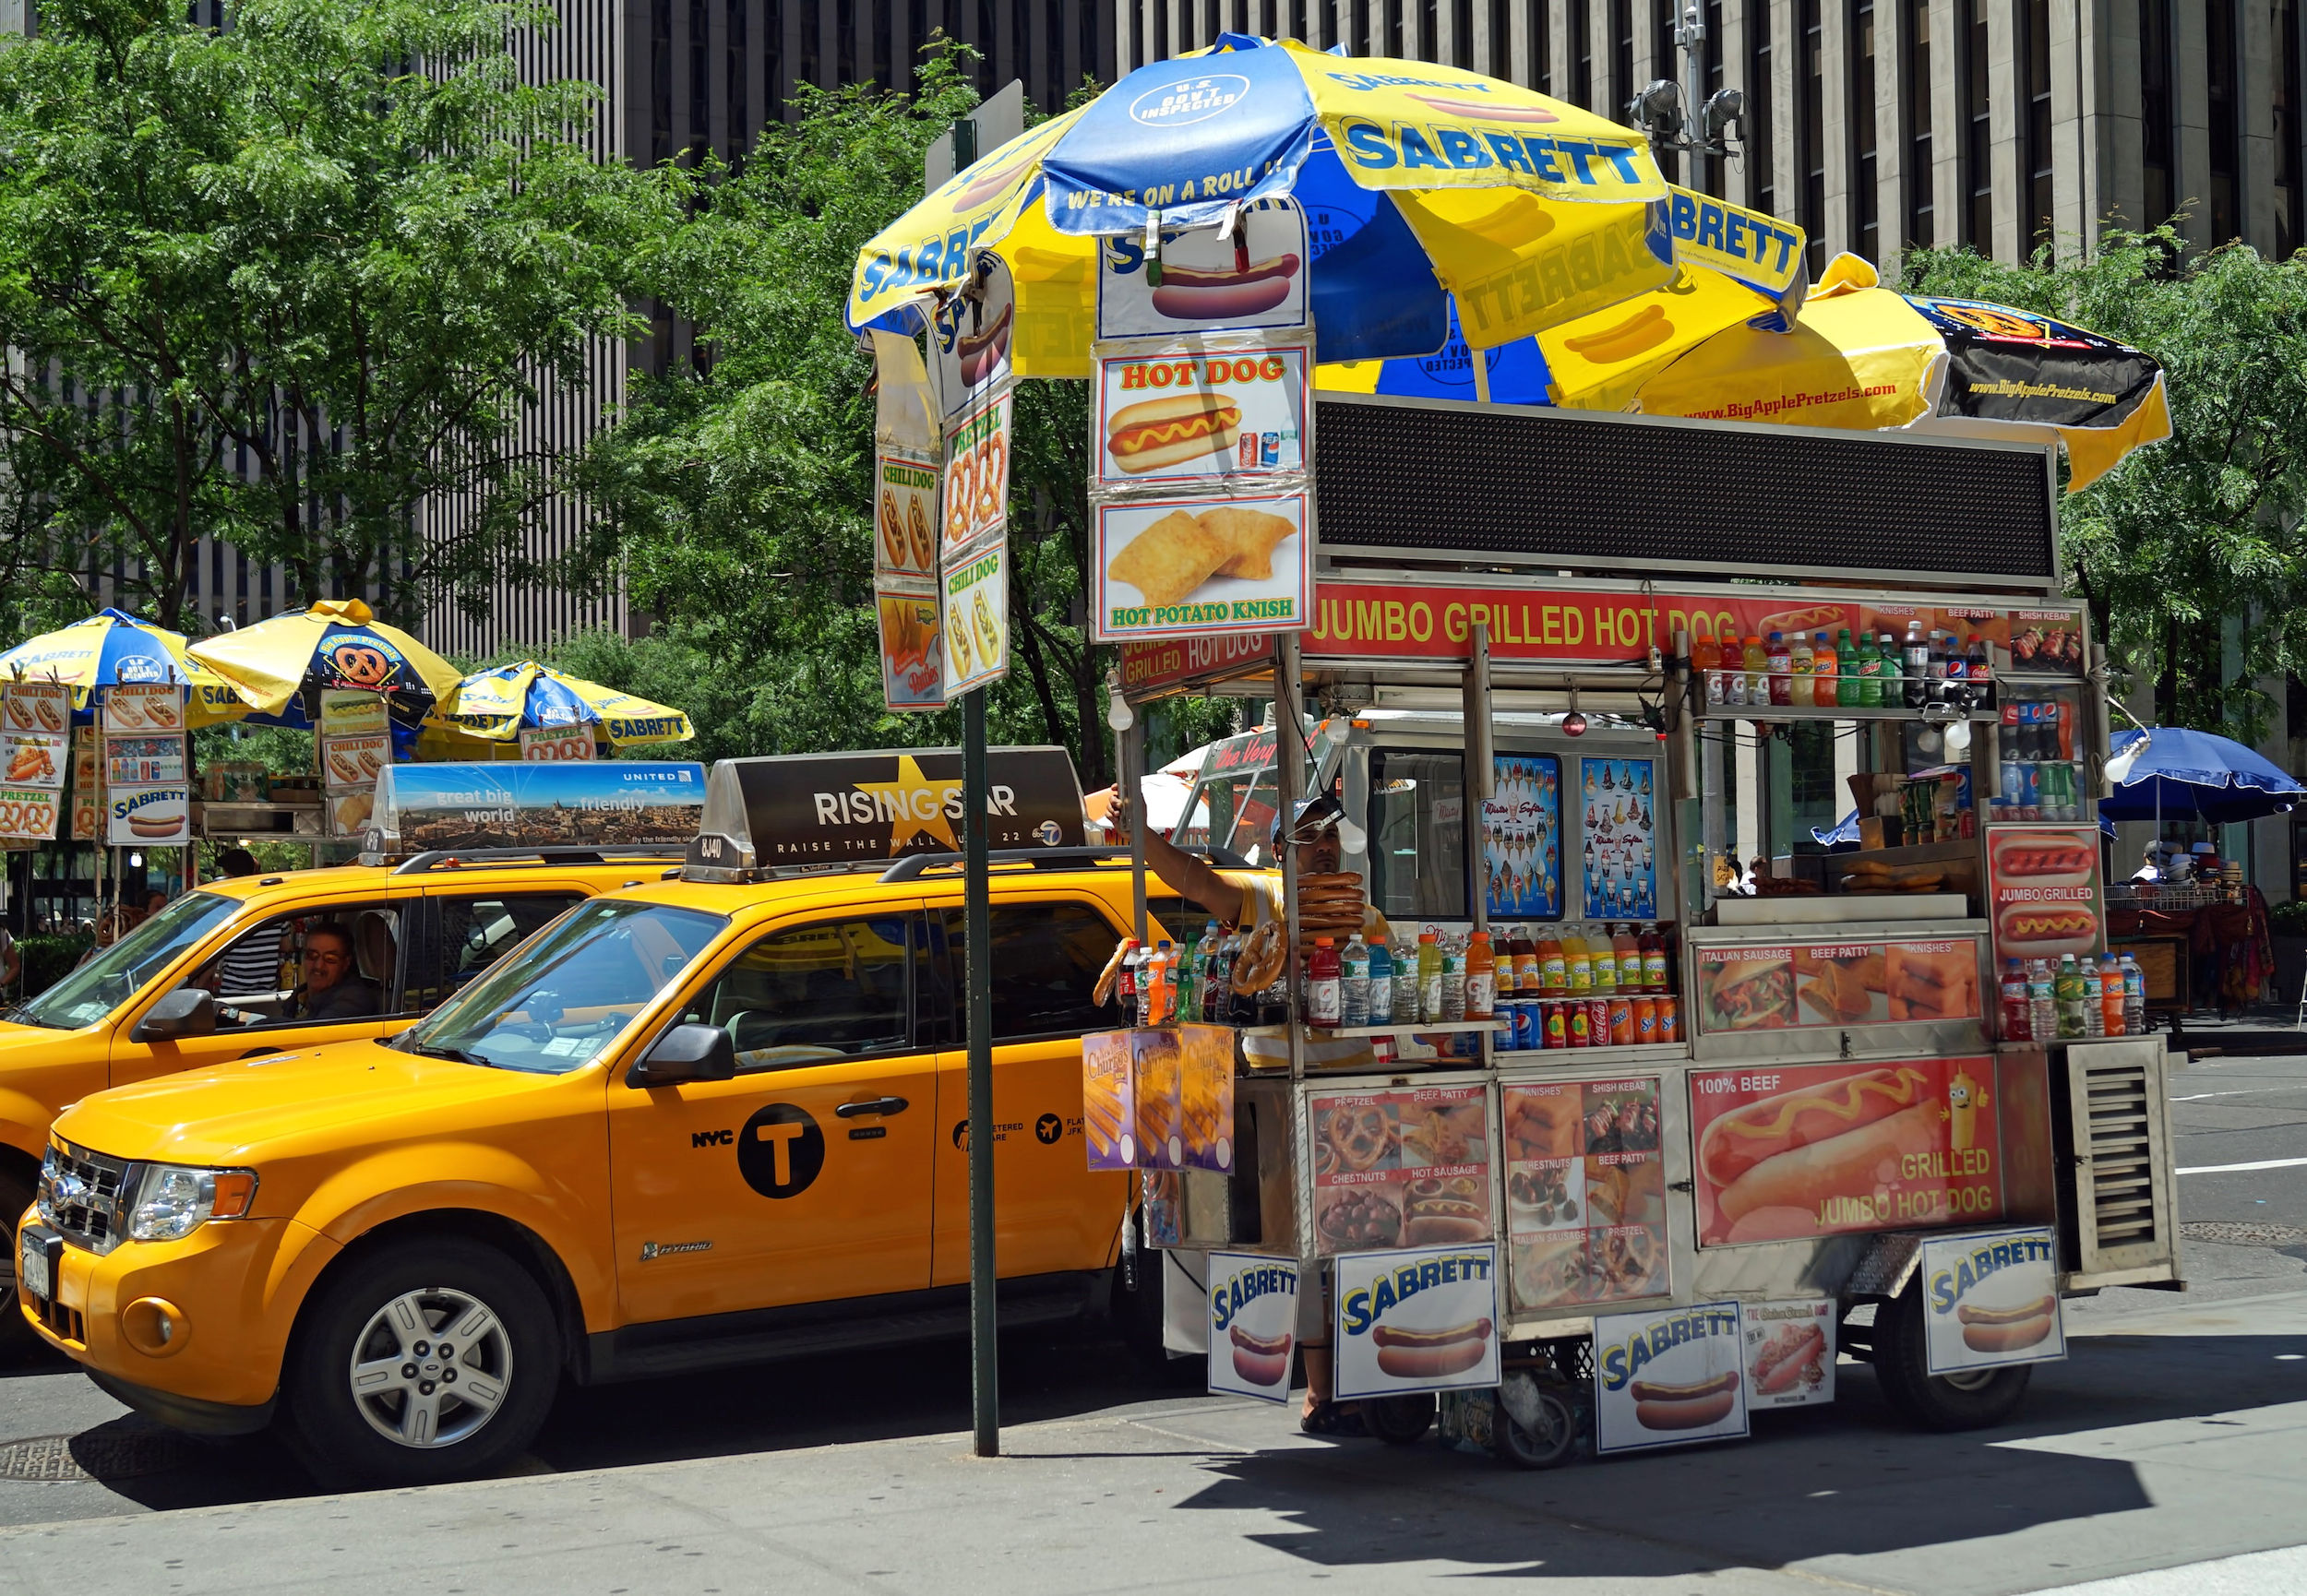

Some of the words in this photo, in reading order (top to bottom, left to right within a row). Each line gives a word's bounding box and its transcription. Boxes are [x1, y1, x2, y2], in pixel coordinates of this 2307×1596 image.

[1326, 72, 1492, 92] SABRETT
[1141, 93, 1236, 119] INSPECTED
[1162, 87, 1221, 107] GOV'T
[1339, 115, 1643, 185] SABRETT
[1068, 189, 1136, 210] WE'RE
[1143, 184, 1175, 208] ON
[1181, 180, 1195, 201] A
[1202, 165, 1256, 198] ROLL
[1667, 186, 1799, 275] BRETT
[858, 205, 1004, 303] SABR
[1119, 360, 1199, 391] HOT
[1204, 355, 1287, 386] DOG
[1968, 379, 2117, 404] www.BigApplePretzels.com
[951, 405, 1002, 459] PRETZEL
[883, 463, 912, 488] CHILI
[912, 470, 935, 491] DOG
[948, 569, 974, 596] CHILI
[975, 554, 999, 584] DOG
[1111, 606, 1151, 628] HOT
[1154, 602, 1228, 625] POTATO
[1232, 597, 1295, 621] KNISH
[1880, 606, 1915, 616] KNISHES
[1948, 609, 1970, 617] BEEF
[1971, 609, 1995, 619] PATTY
[2019, 611, 2042, 620] SHISH
[2043, 612, 2071, 621] KEBAB
[1313, 599, 1434, 641] JUMBO
[1444, 602, 1585, 646] GRILLED
[1595, 606, 1659, 648] HOT
[1669, 609, 1736, 644] DOG
[320, 640, 336, 653] Big
[330, 634, 359, 645] Apple
[361, 635, 399, 660] Pretzels
[1189, 636, 1219, 671] HOT
[1226, 633, 1263, 661] DOG
[15, 650, 94, 668] SABRETT
[1126, 649, 1181, 684] GRILLED
[10, 686, 39, 697] CHILI
[41, 688, 63, 698] DOG
[113, 686, 148, 697] CHILI
[149, 685, 175, 696] DOG
[530, 727, 585, 743] PRETZEL
[610, 716, 684, 739] SABRETT
[330, 742, 360, 752] CHILI
[362, 740, 384, 750] DOG
[1215, 744, 1241, 770] the
[1242, 736, 1278, 768] Very
[623, 772, 675, 781] UNITED
[1, 791, 53, 803] PRETZEL
[112, 789, 185, 819] SABRETT
[436, 790, 481, 805] great
[486, 789, 513, 805] big
[580, 796, 646, 814] friendly
[814, 788, 939, 826] RISING
[941, 784, 1018, 820] SR
[464, 808, 515, 822] world
[632, 835, 640, 844] fly
[642, 835, 652, 843] the
[654, 835, 683, 844] friendly
[778, 841, 831, 854] RAISE
[844, 839, 878, 850] THE
[891, 836, 936, 848] WALL
[1002, 831, 1021, 841] 22
[1032, 828, 1045, 839] abc
[701, 839, 722, 859] 8J40
[2000, 888, 2041, 901] JUMBO
[2044, 887, 2094, 901] GRILLED
[1702, 950, 1741, 963] ITALIAN
[1743, 947, 1792, 961] SAUSAGE
[1811, 947, 1838, 959] BEEF
[1840, 946, 1869, 958] PATTY
[1910, 941, 1952, 954] KNISHES
[1087, 1046, 1129, 1080] Churros
[1524, 1085, 1561, 1097] KNISHES
[1592, 1081, 1617, 1093] SHISH
[1619, 1080, 1646, 1091] KEBAB
[1698, 1078, 1737, 1095] 100%
[1740, 1075, 1780, 1091] BEEF
[1334, 1095, 1376, 1107] PRETZEL
[1414, 1089, 1439, 1102] BEEF
[1440, 1088, 1468, 1101] PATTY
[993, 1122, 1023, 1132] ETERED
[1067, 1126, 1082, 1136] JFK
[692, 1129, 734, 1148] NYC
[757, 1121, 804, 1186] T
[1598, 1154, 1623, 1165] BEEF
[1623, 1152, 1645, 1164] PATTY
[1412, 1167, 1431, 1178] HOT
[1432, 1164, 1476, 1177] SAUSAGE
[1523, 1158, 1572, 1171] CHESTNUTS
[1901, 1148, 1990, 1180] GRILLED
[1332, 1171, 1386, 1185] CHESTNUTS
[1815, 1194, 1891, 1227] JUMBO
[1897, 1189, 1941, 1220] HOT
[1947, 1186, 1991, 1216] DOG
[1513, 1233, 1545, 1245] ITALIAN
[1546, 1230, 1586, 1243] SAUSAGE
[1608, 1226, 1644, 1237] PRETZEL
[1929, 1237, 2052, 1316] SABRETT
[1212, 1263, 1297, 1331] SABRETT
[1342, 1254, 1491, 1336] SABRETT
[1600, 1310, 1739, 1391] SABRETT
